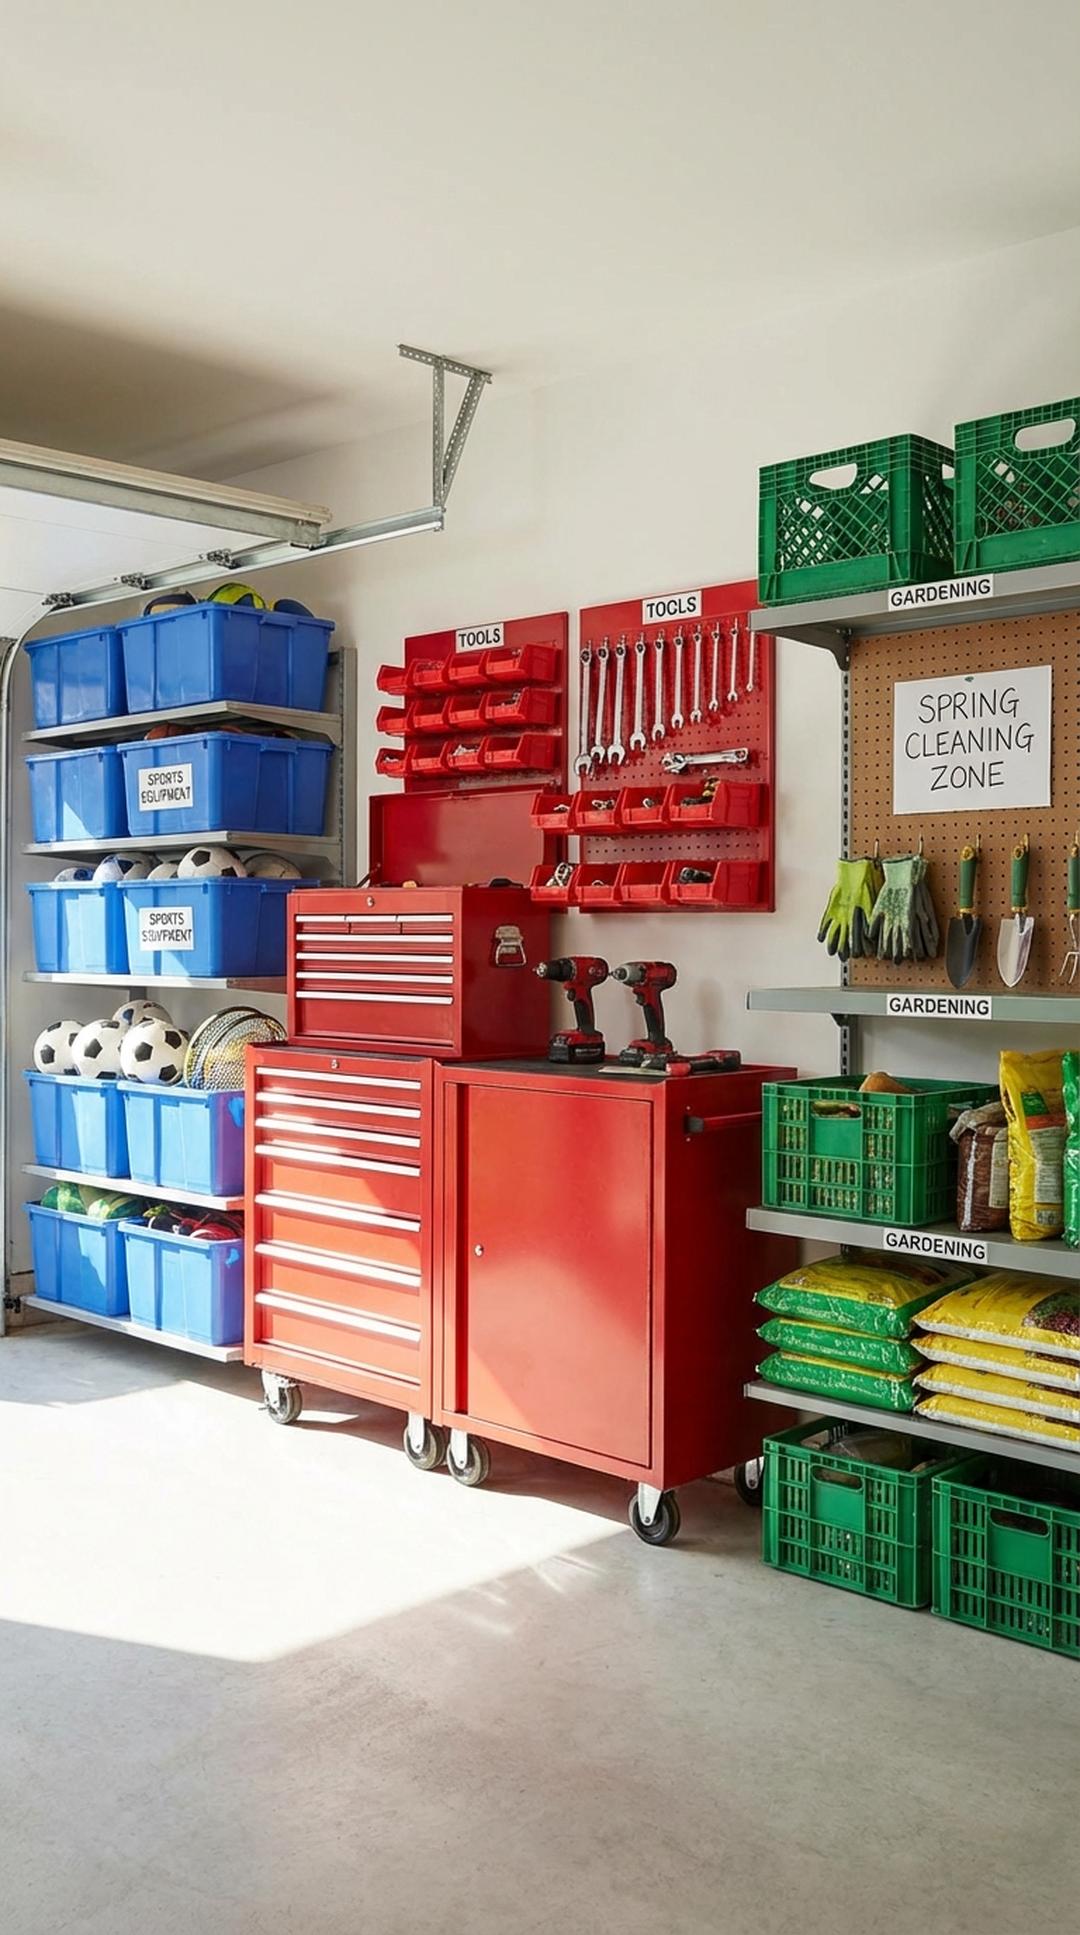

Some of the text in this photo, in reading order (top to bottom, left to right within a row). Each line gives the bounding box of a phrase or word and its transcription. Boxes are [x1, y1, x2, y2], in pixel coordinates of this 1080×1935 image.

[891, 579, 991, 607] GARDENING
[458, 628, 501, 647] TOOLS
[918, 687, 1020, 723] SPRING
[905, 722, 1035, 759] CLEANING
[147, 770, 184, 786] SPORTS
[930, 761, 1004, 791] ZONE
[149, 912, 185, 926] SPORTS
[889, 997, 989, 1015] GARDENING
